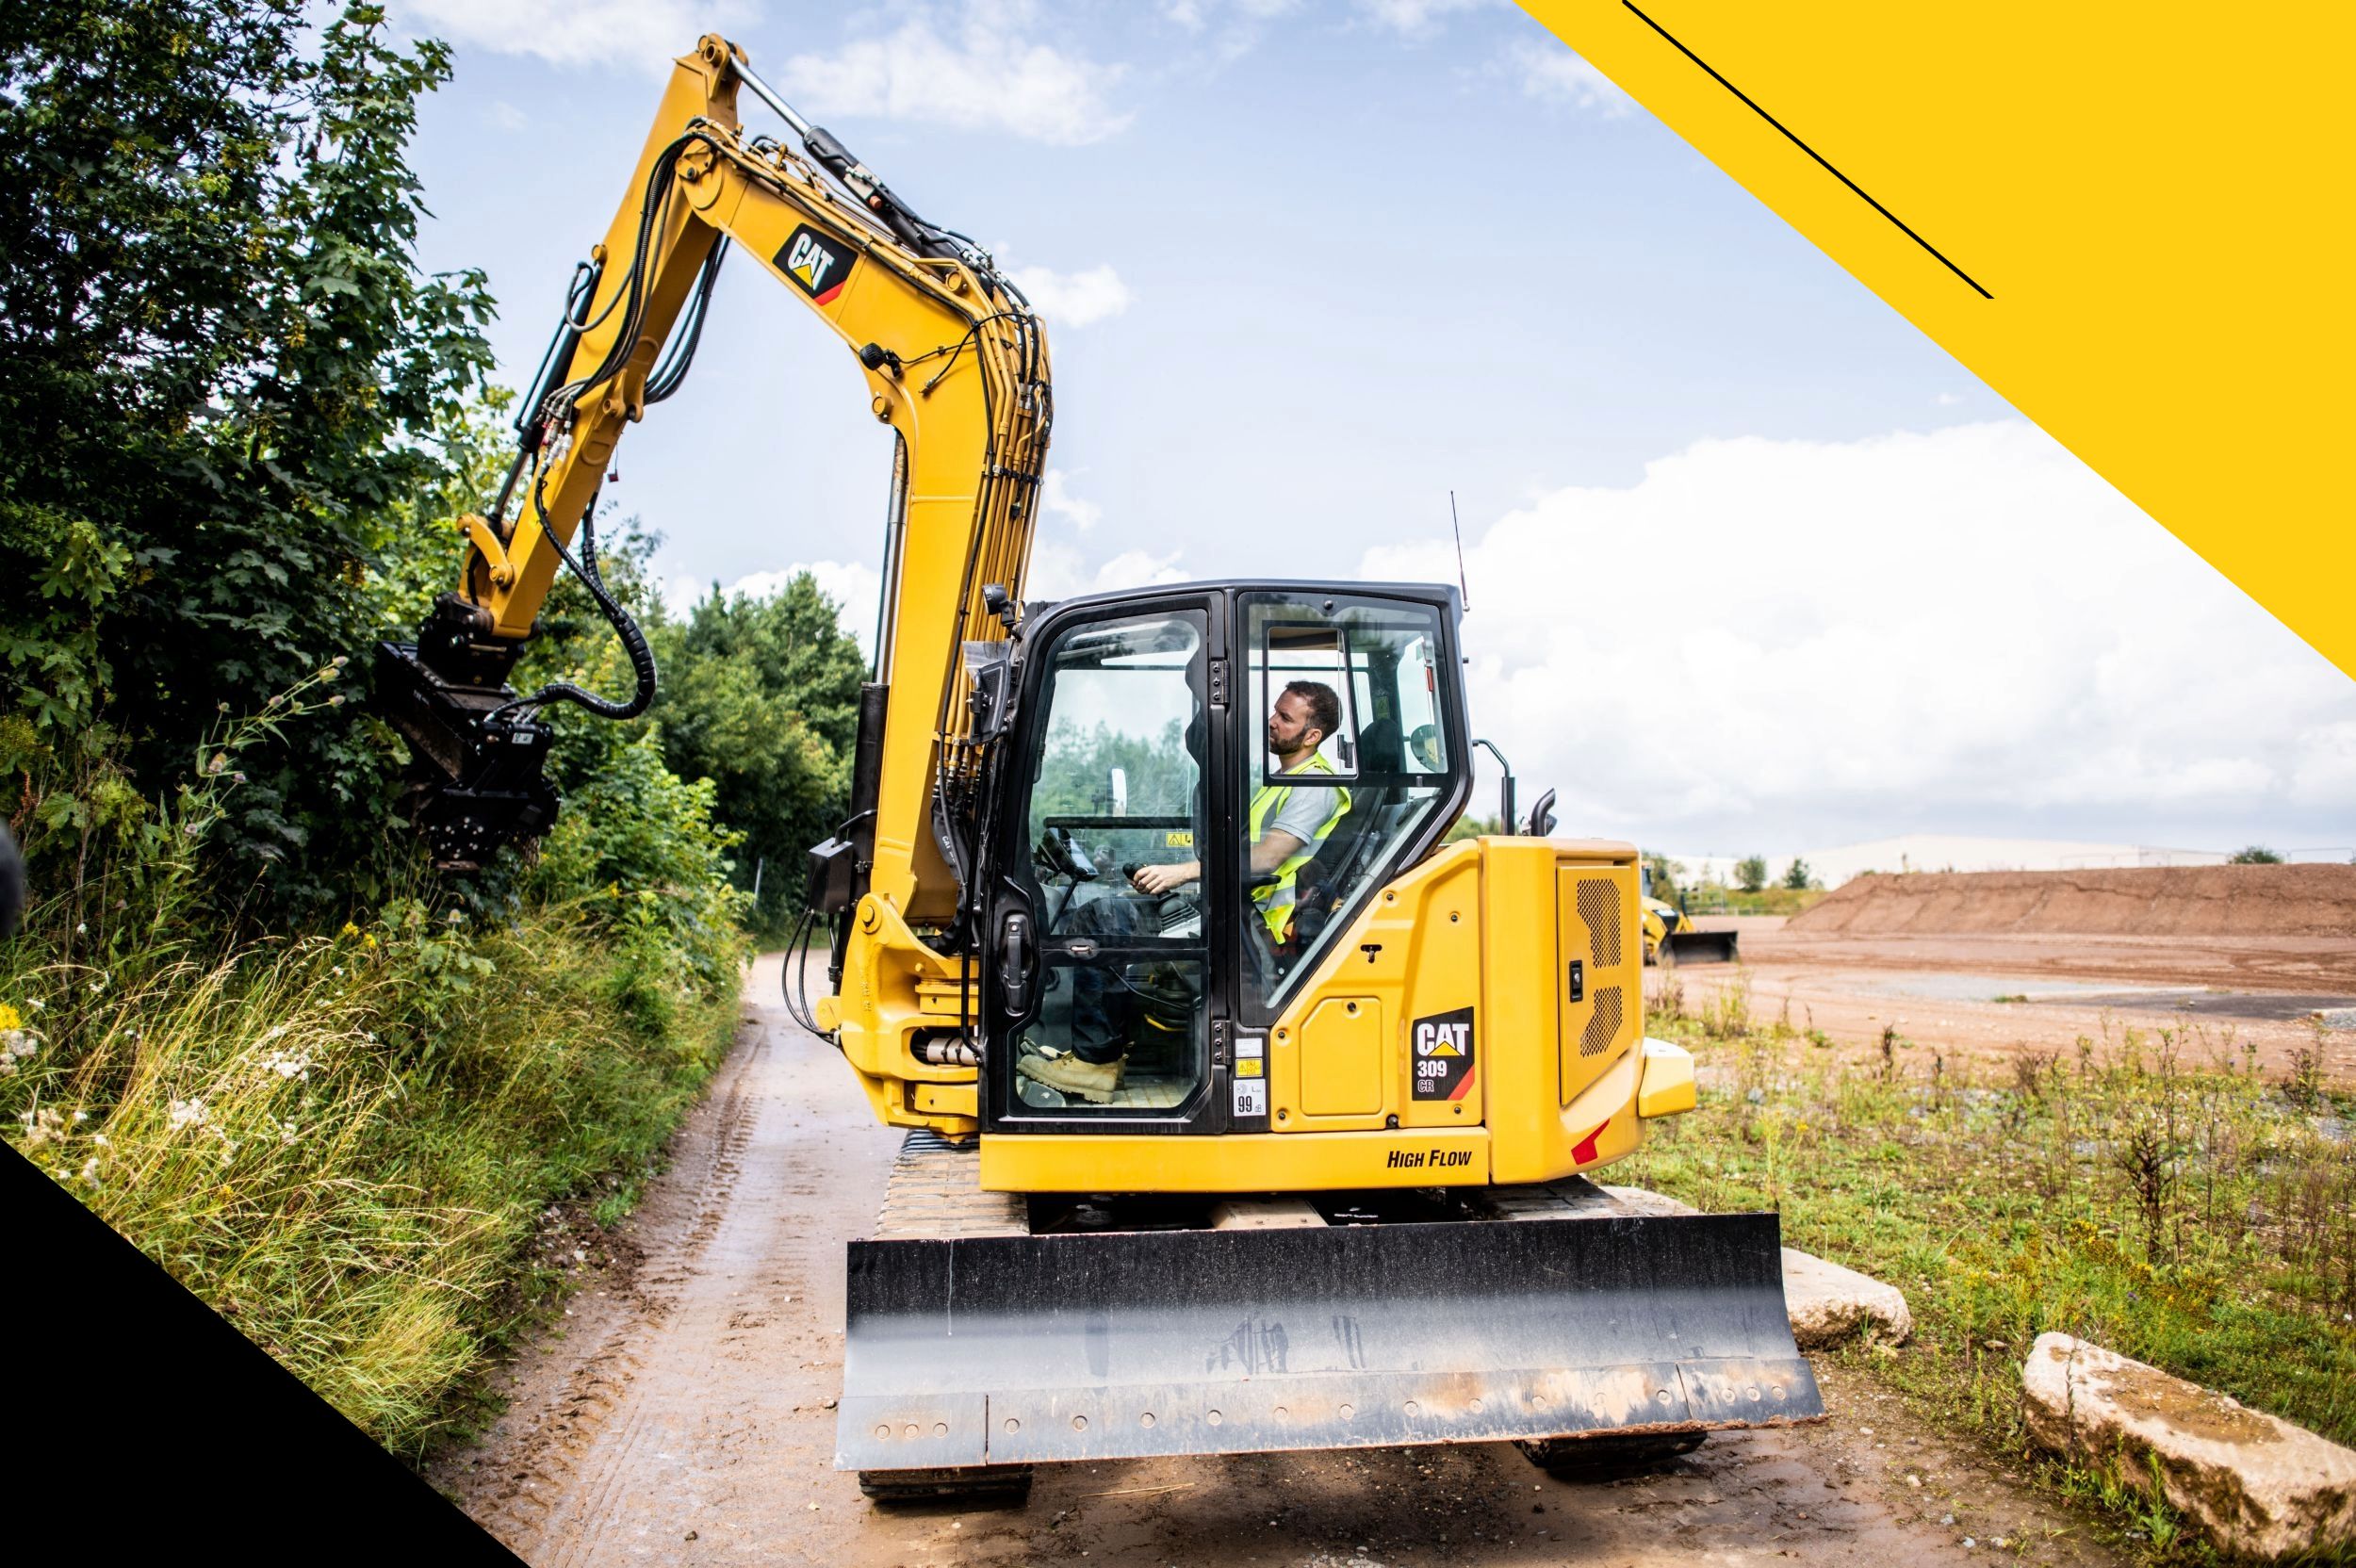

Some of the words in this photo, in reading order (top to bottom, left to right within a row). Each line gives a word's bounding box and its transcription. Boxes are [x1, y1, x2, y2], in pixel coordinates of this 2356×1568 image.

[788, 233, 835, 291] CAT
[1416, 1023, 1469, 1056] CAT
[1417, 1060, 1448, 1077] 309
[1417, 1079, 1434, 1093] CR
[1238, 1096, 1252, 1112] 99
[1387, 1151, 1425, 1168] HIGH
[1429, 1150, 1472, 1167] FLOW
